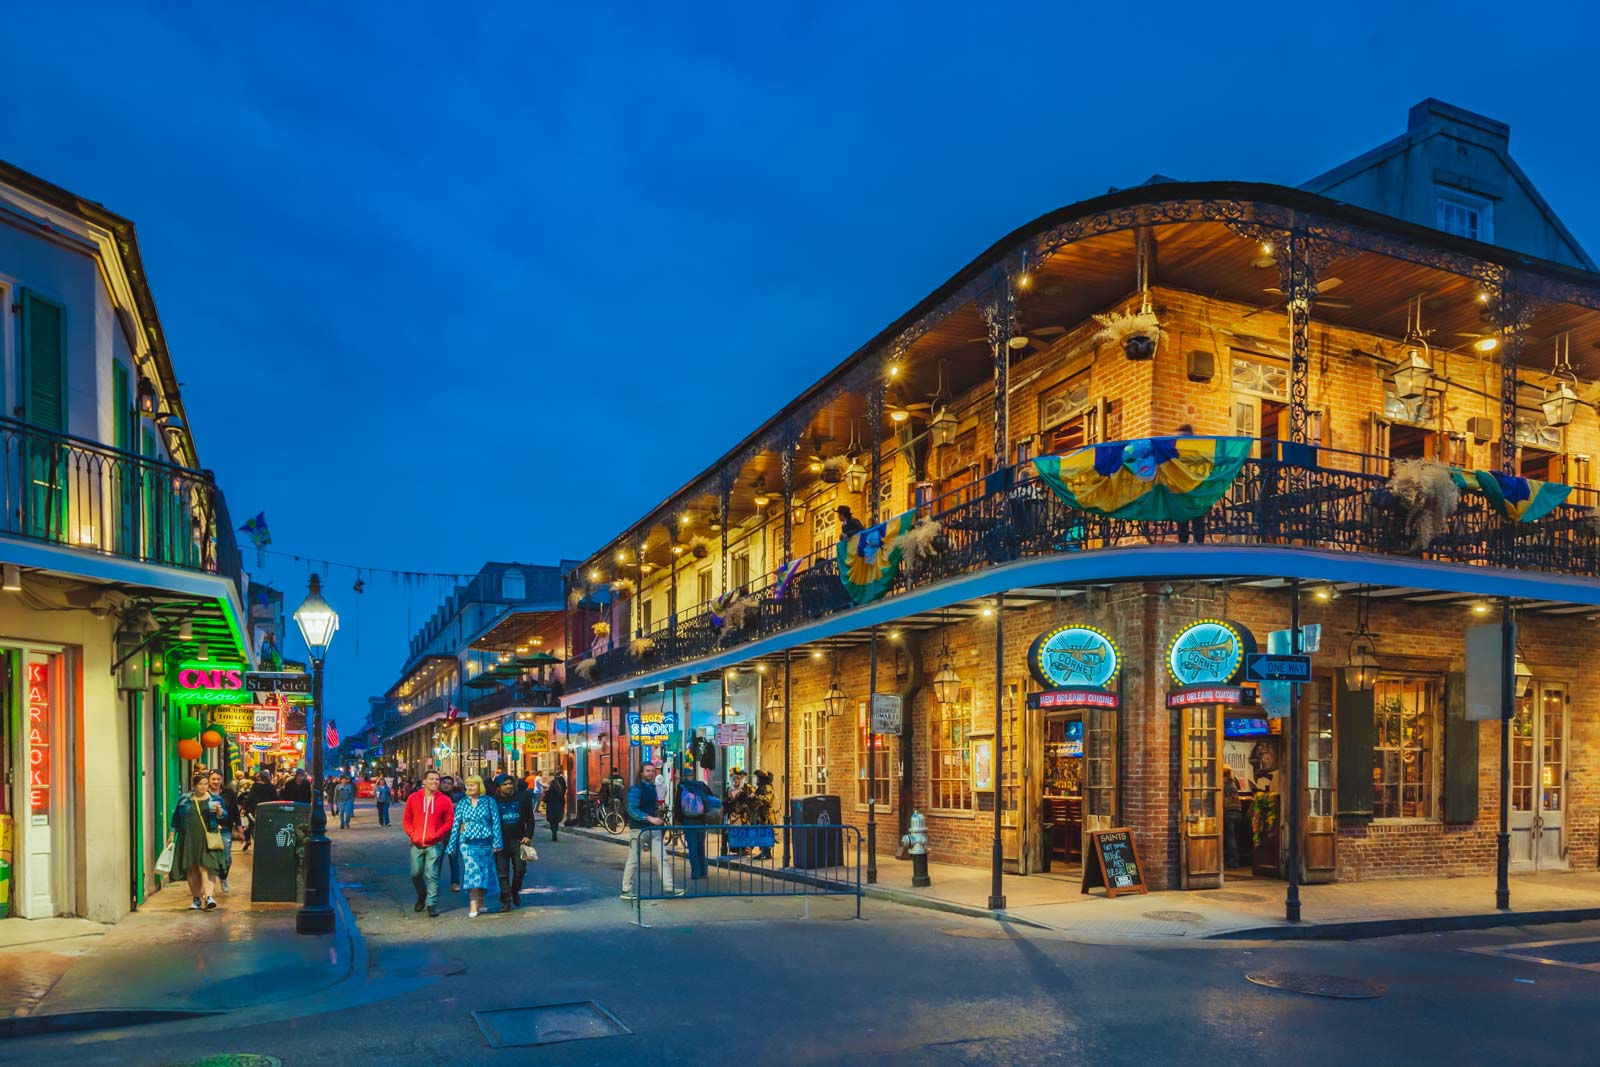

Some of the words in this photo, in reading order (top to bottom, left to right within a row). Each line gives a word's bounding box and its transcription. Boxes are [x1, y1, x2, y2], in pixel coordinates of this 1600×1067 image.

[1058, 653, 1094, 676] CORNET
[1188, 651, 1221, 672] CORNET
[1267, 662, 1285, 673] ONE
[1288, 663, 1304, 674] WAY
[247, 679, 267, 690] St.
[272, 679, 307, 691] Peter
[177, 692, 240, 702] meow
[1040, 696, 1055, 704] NEW
[1056, 694, 1086, 703] ORLEANS
[1087, 694, 1114, 704] CUISINE
[1172, 695, 1185, 704] NEW
[1186, 691, 1213, 701] ORLEANS
[1214, 690, 1239, 699] CUISINE
[642, 714, 664, 722] HOLY
[28, 664, 43, 806] KARAOKE
[1101, 833, 1126, 842] SAINTS
